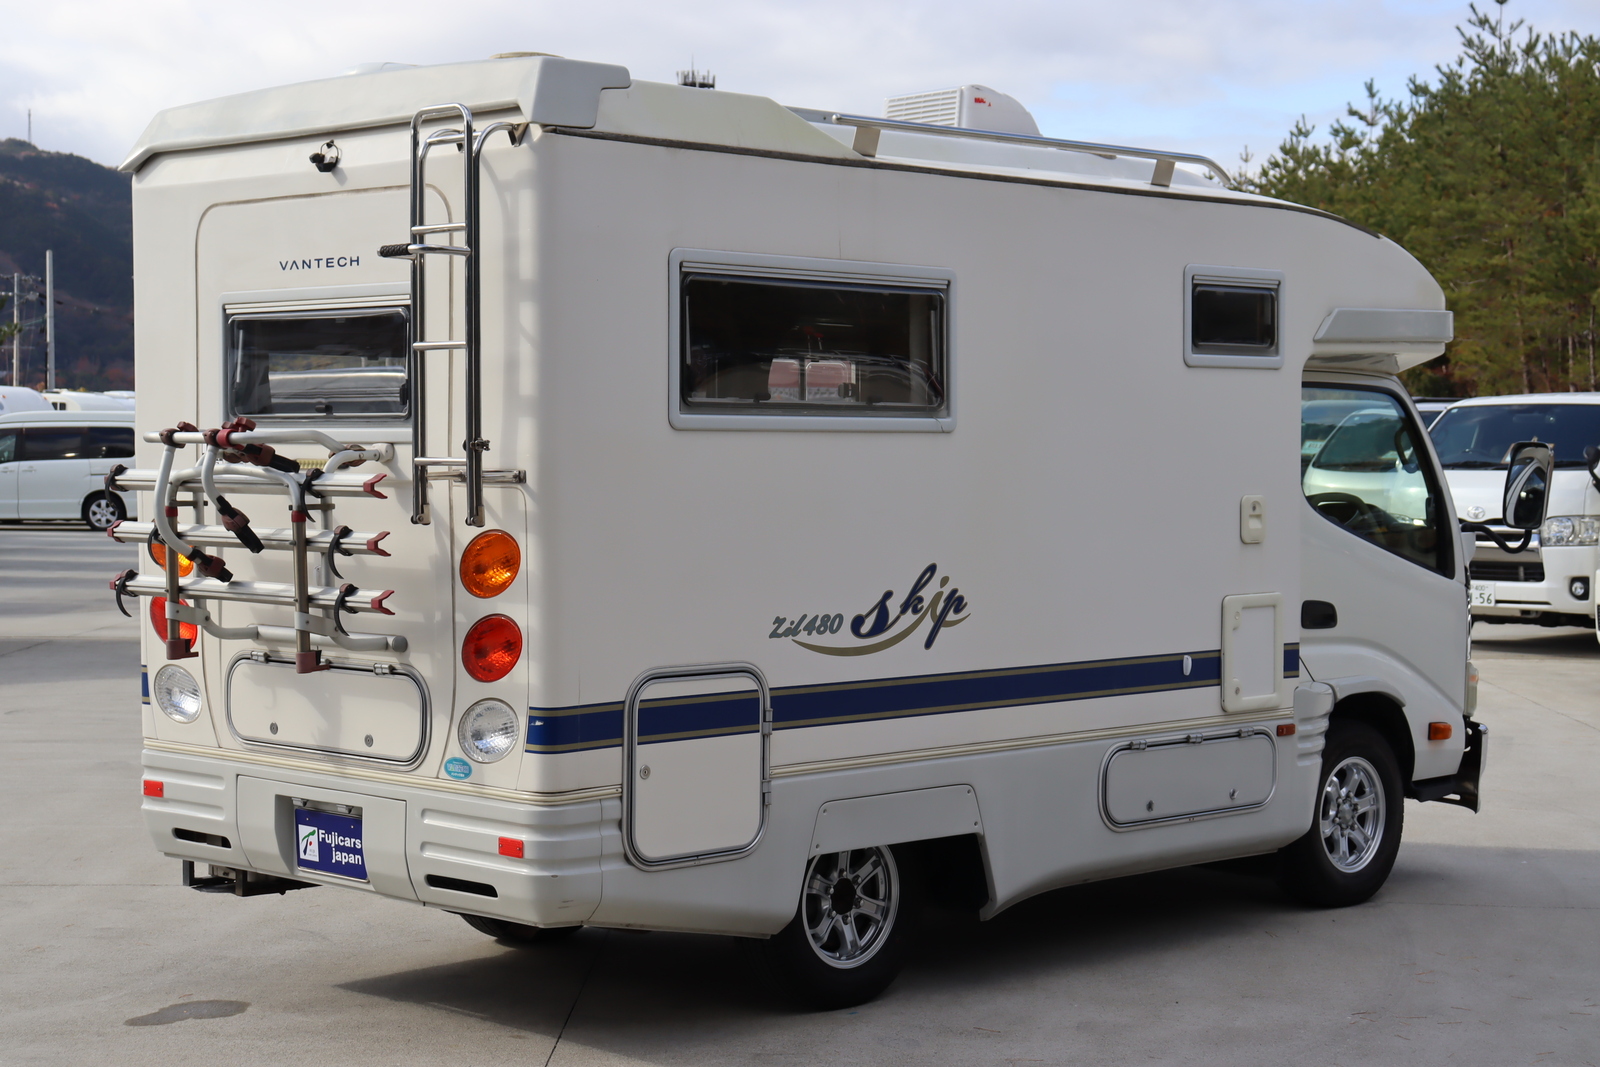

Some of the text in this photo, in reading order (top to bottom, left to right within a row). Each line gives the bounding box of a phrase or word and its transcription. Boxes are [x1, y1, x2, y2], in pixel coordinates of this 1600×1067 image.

[279, 255, 360, 271] VANTECH
[318, 828, 362, 850] Fujicars
[331, 847, 362, 865] japan
